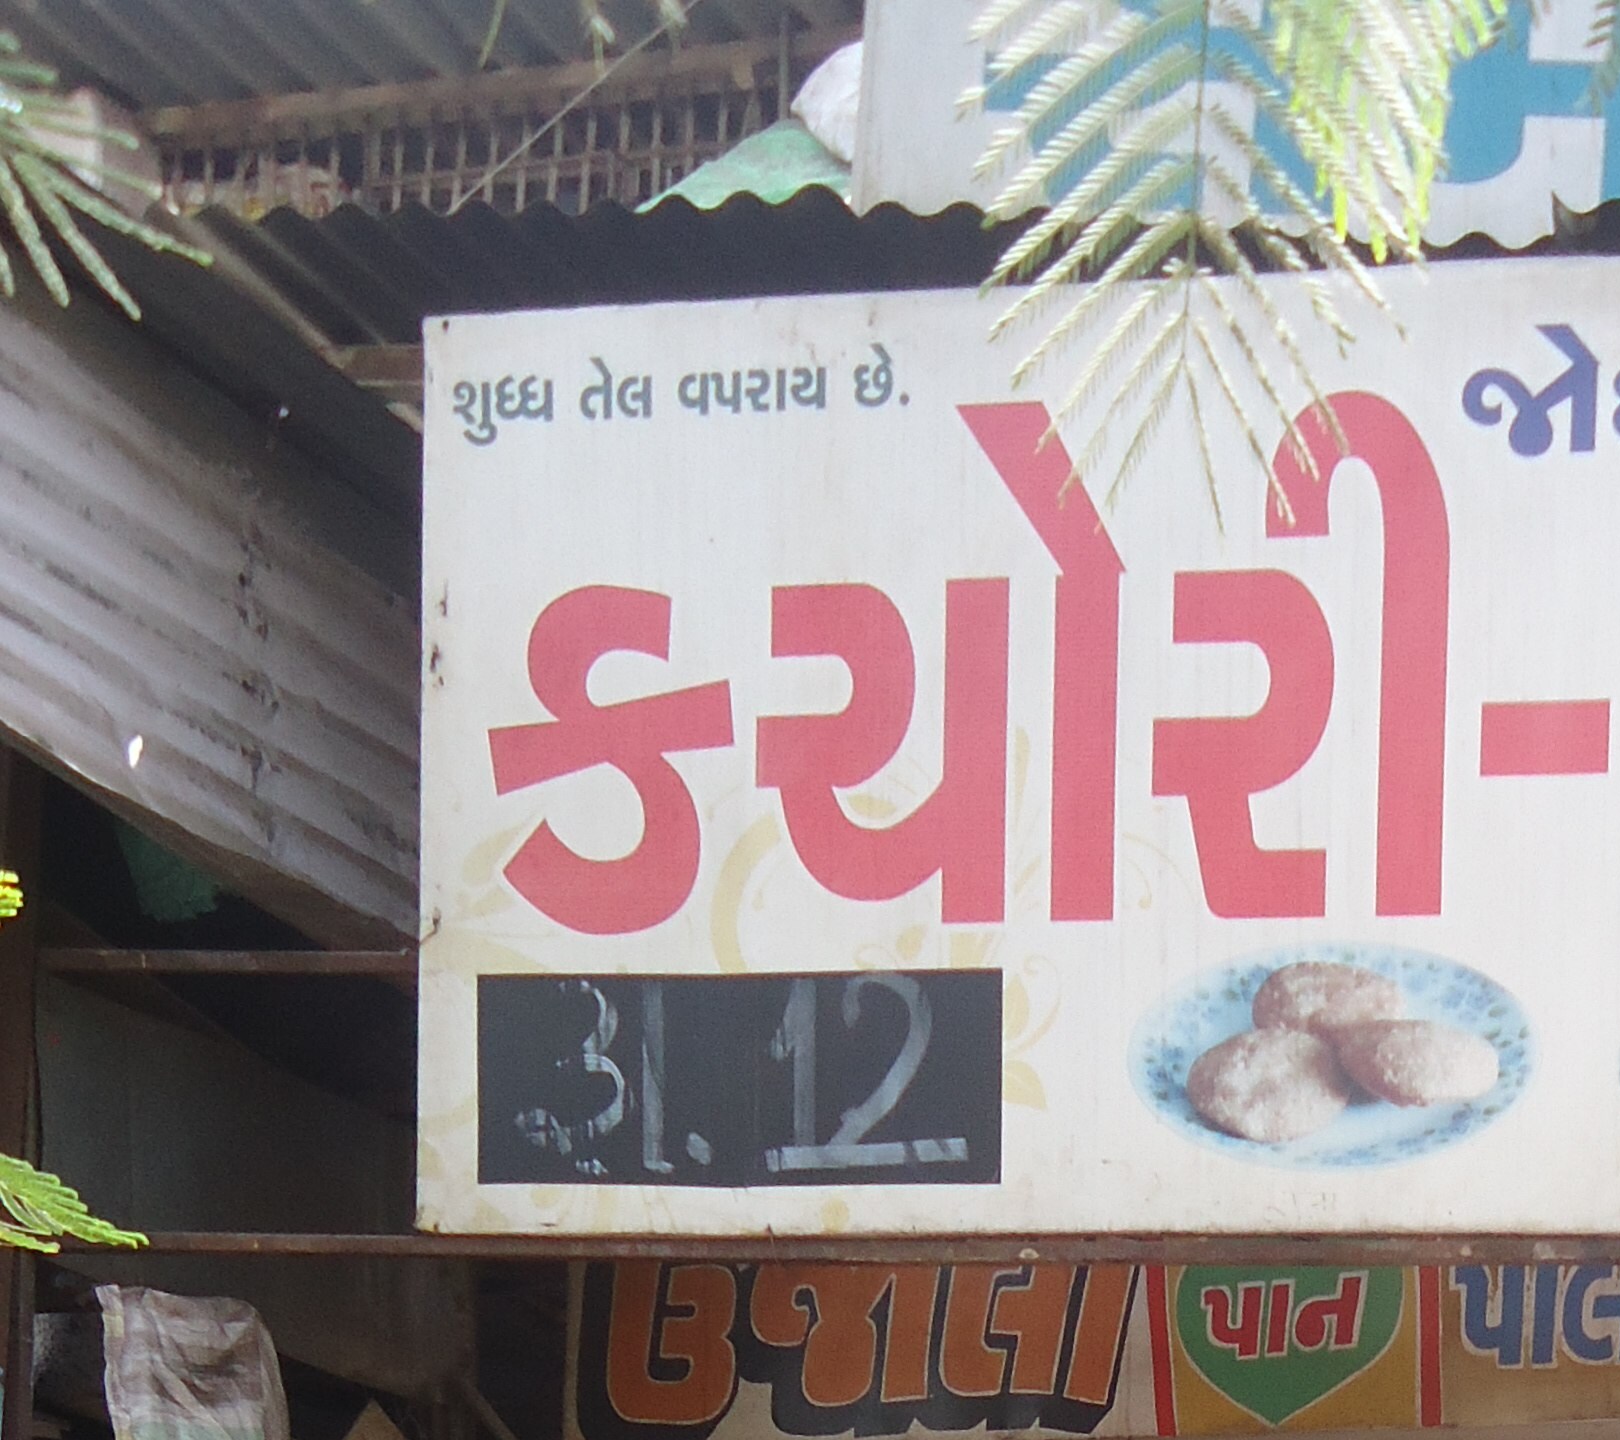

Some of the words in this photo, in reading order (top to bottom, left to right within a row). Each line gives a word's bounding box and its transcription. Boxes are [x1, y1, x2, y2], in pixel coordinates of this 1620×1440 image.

[452, 375, 554, 447] શુધ્ધ
[579, 356, 652, 420] તેલ
[677, 365, 827, 416] વપરાય
[853, 342, 910, 408] છે.
[1202, 1270, 1368, 1360] પાન
